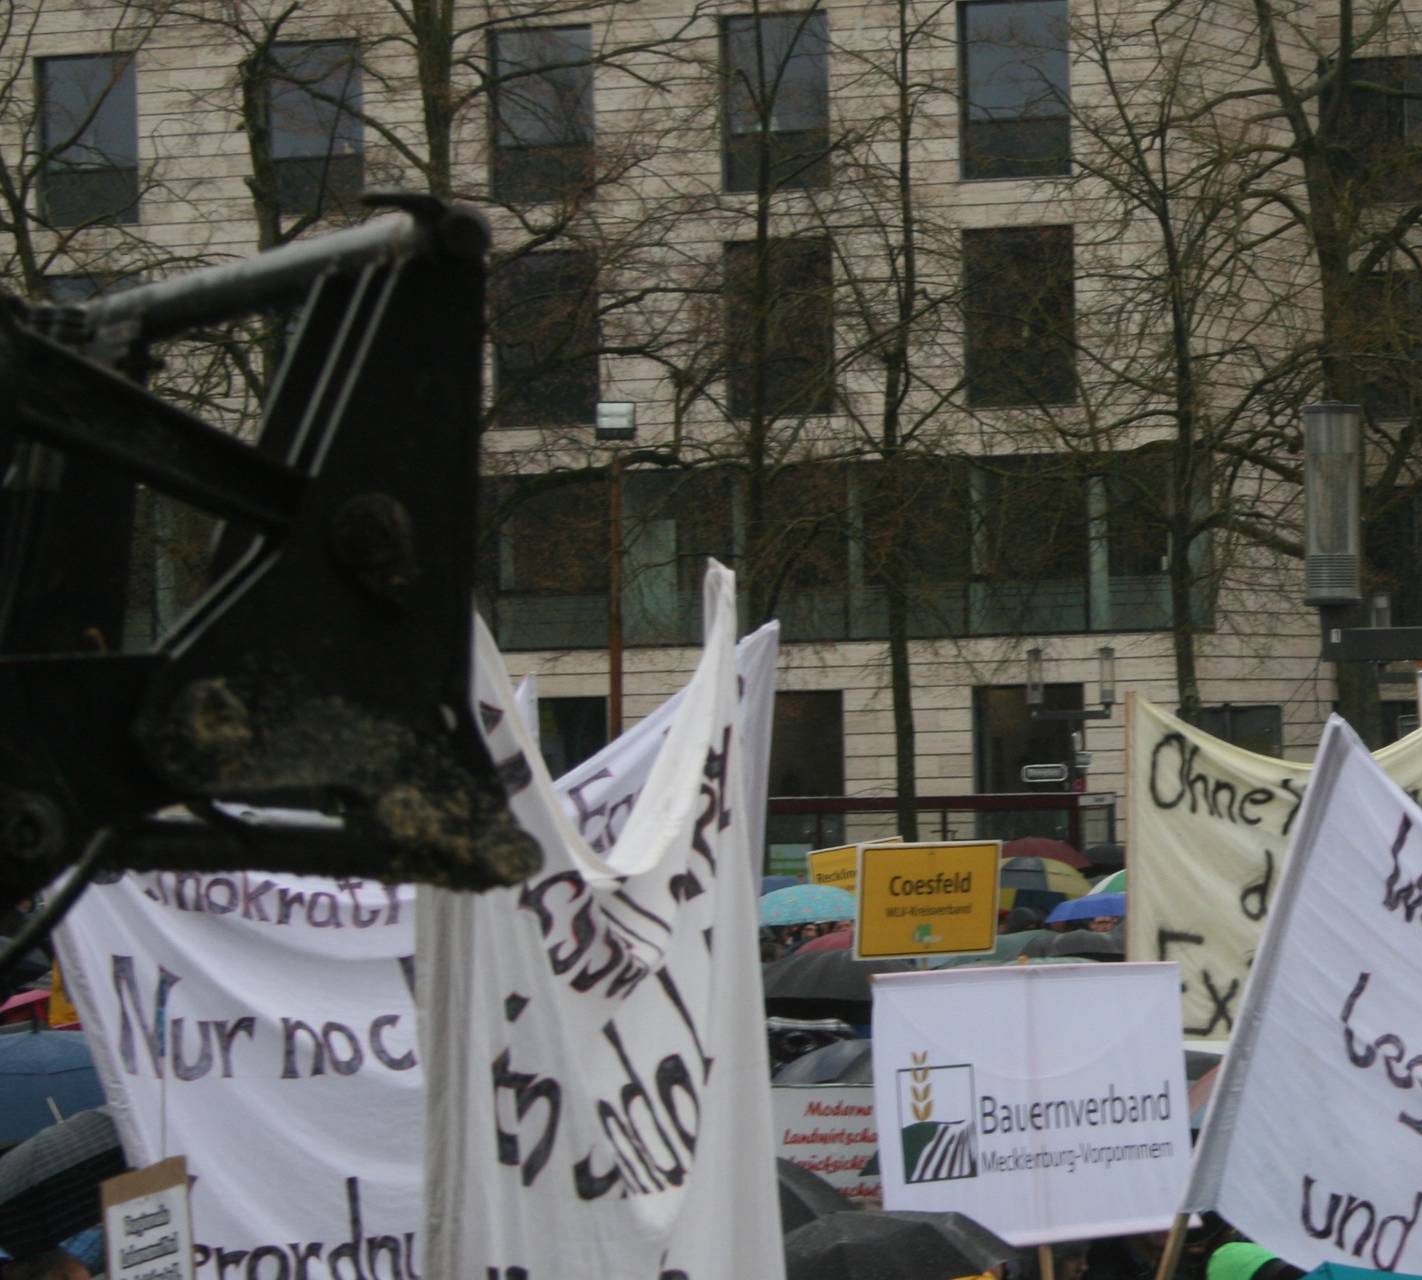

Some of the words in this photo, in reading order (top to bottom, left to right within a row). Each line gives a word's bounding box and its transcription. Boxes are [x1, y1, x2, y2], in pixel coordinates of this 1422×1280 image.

[889, 872, 972, 896] Coesfeld
[112, 955, 257, 1081] Nur
[981, 1081, 1171, 1135] Bauernverband
[982, 1138, 1175, 1172] Mecklenburg-Vorpommern
